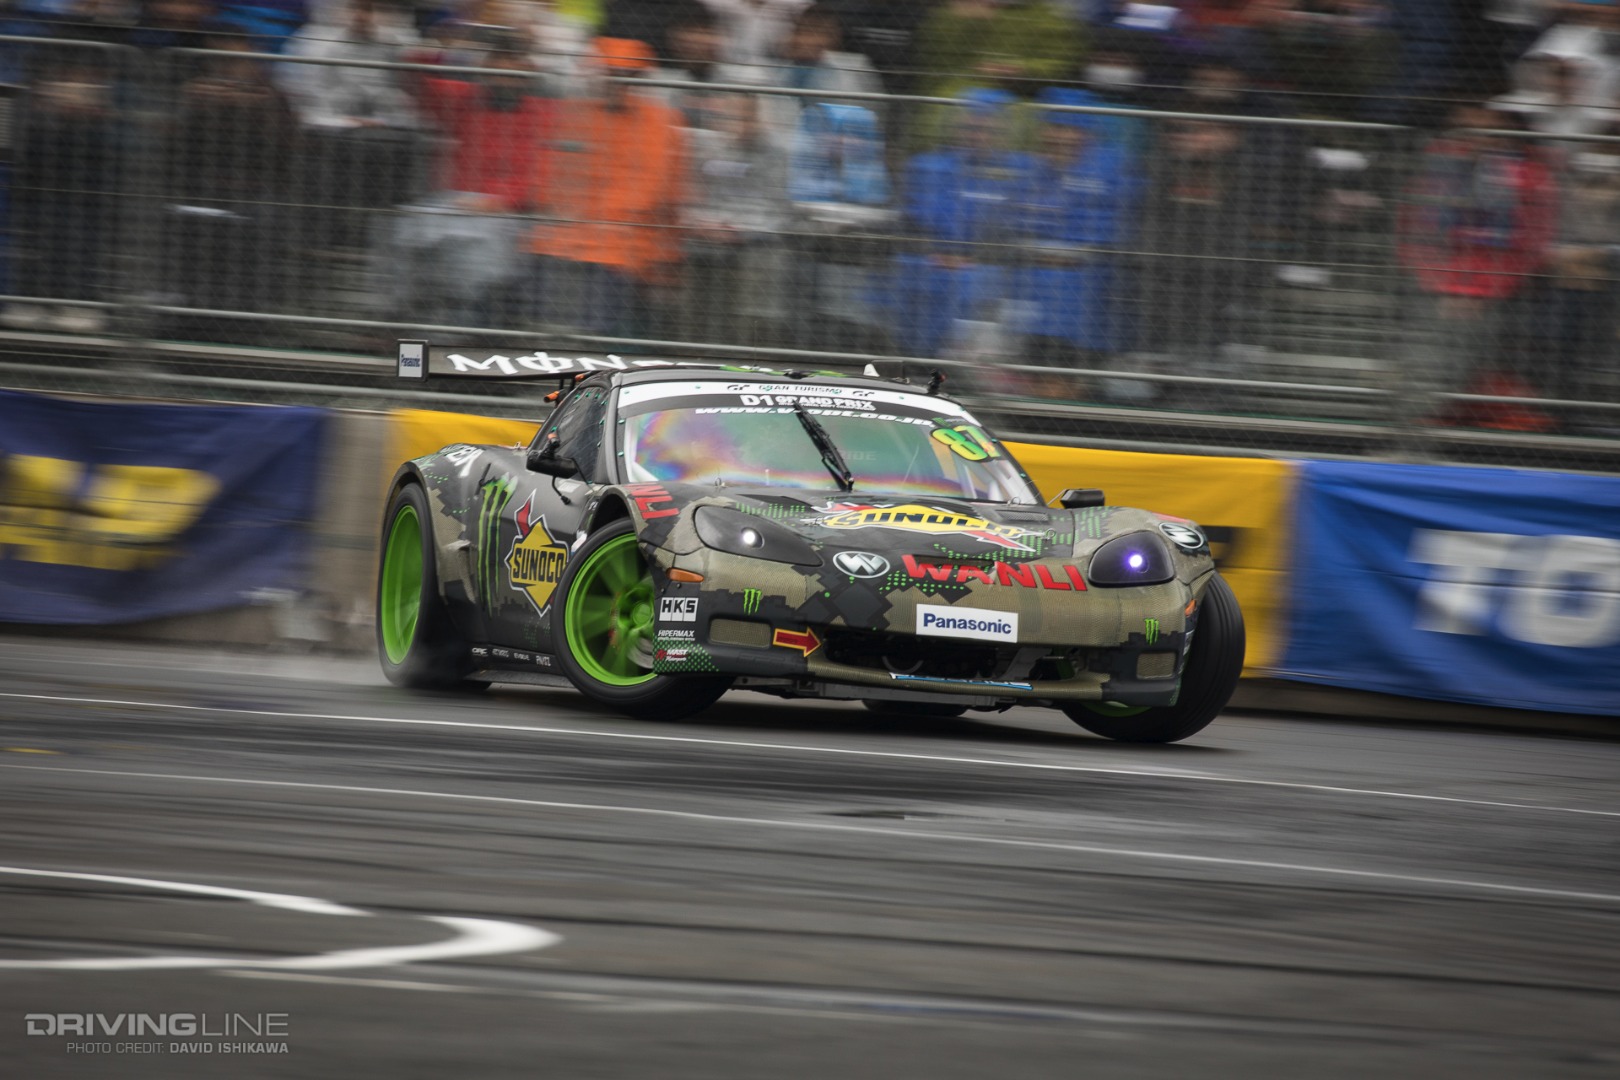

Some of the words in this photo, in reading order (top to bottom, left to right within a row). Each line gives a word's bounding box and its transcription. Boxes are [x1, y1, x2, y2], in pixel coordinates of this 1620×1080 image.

[758, 384, 790, 392] GRAN
[794, 385, 843, 395] TURISMO
[739, 394, 775, 406] D1
[833, 398, 874, 409] PRIX
[512, 547, 567, 583] SUNOCO
[902, 554, 1088, 592] WANLI
[661, 598, 697, 615] HKS
[922, 612, 1012, 635] Panasonic
[658, 630, 695, 638] HIPERMAX
